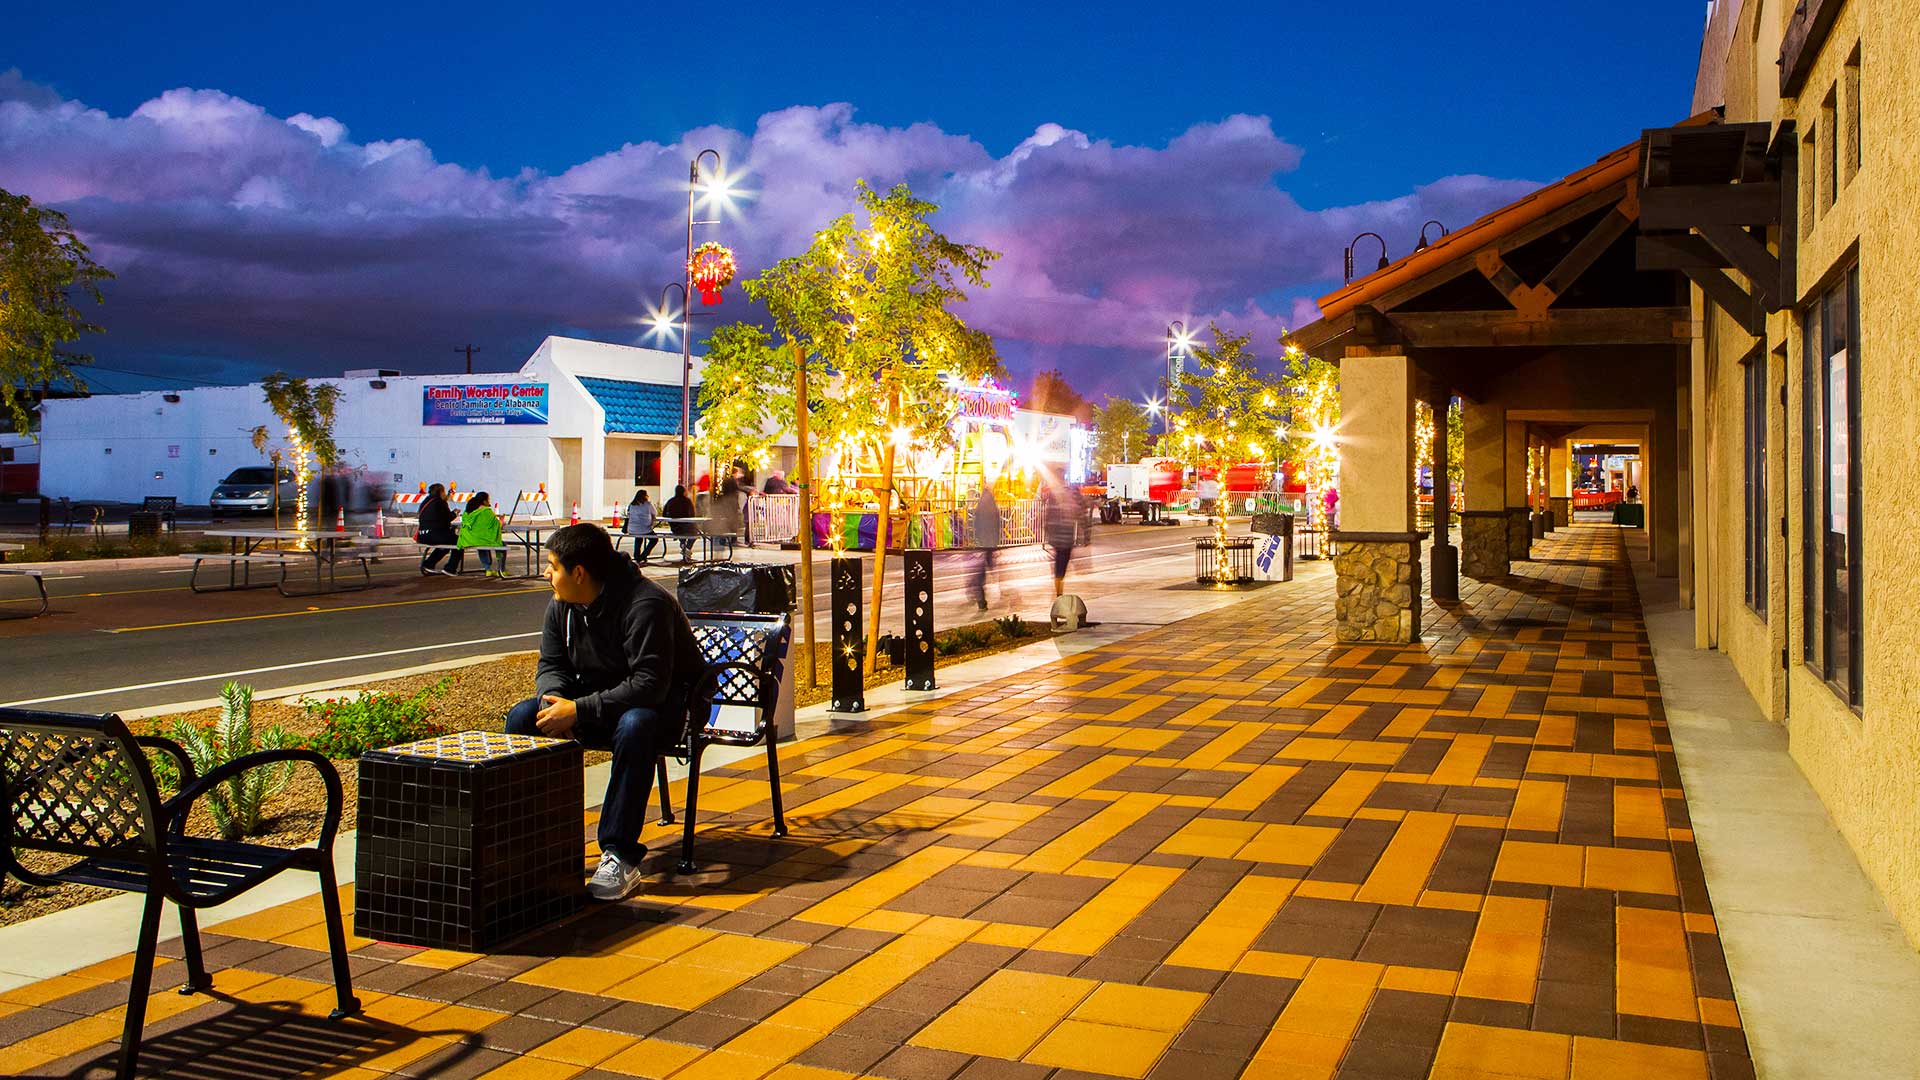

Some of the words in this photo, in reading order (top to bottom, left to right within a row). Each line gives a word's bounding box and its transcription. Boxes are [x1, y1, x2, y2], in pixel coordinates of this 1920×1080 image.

[428, 386, 463, 401] Family
[465, 385, 510, 400] Worship
[511, 384, 544, 398] Center
[435, 401, 459, 410] Centro
[461, 400, 492, 409] Familiar
[494, 399, 503, 409] de
[505, 399, 540, 408] Alabanza
